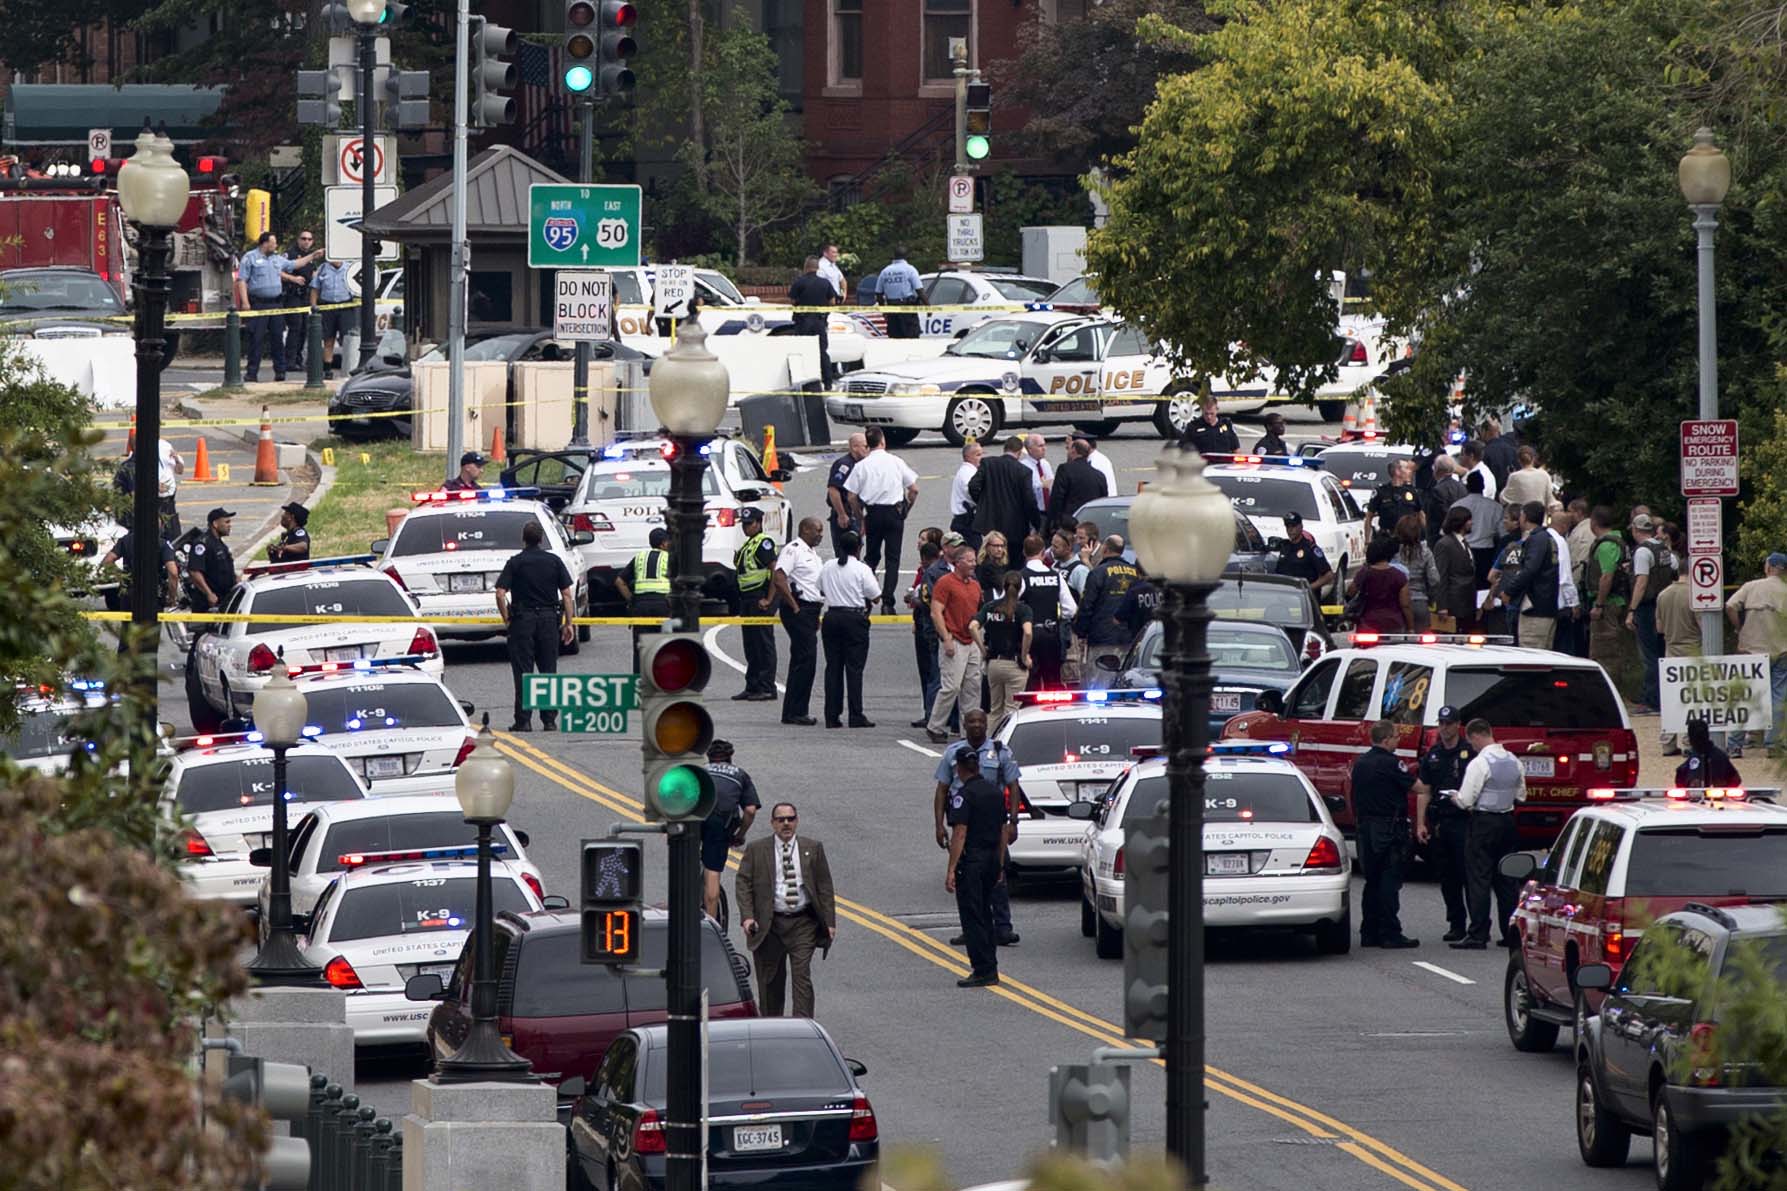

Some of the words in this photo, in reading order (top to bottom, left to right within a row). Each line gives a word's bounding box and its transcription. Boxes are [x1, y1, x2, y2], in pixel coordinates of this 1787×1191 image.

[581, 189, 590, 199] TO
[604, 201, 621, 211] EAST
[550, 227, 572, 245] 95
[601, 224, 625, 242] 50
[661, 269, 687, 279] STOP
[559, 281, 577, 296] DO
[582, 281, 608, 296] NOT
[664, 288, 684, 297] RED
[558, 303, 607, 319] BLOCK
[558, 322, 608, 334] INTERSECTION
[1050, 370, 1145, 395] POLICE
[1691, 424, 1727, 436] SNOW
[1684, 436, 1734, 444] EMERGENCY
[1688, 445, 1732, 456] ROUTE
[1685, 458, 1697, 467] NO
[1701, 458, 1734, 467] PARKING
[1352, 472, 1377, 480] K-9
[1695, 468, 1725, 477] DURING
[1685, 479, 1734, 487] EMERGENCY
[1230, 497, 1256, 506] K-9
[623, 507, 664, 517] POLI
[457, 531, 483, 541] K-9
[1106, 565, 1137, 577] POLICE
[1029, 576, 1059, 587] POLICE
[315, 603, 342, 614] K-9
[1665, 662, 1765, 683] SIDEWALK
[530, 677, 629, 707] FIRST
[356, 708, 386, 719] K-9
[1685, 708, 1749, 726] AHEAD
[563, 712, 624, 732] 1-200
[1079, 745, 1111, 754] K-9
[252, 782, 275, 793] K-
[1550, 786, 1580, 798] CHIEF
[1205, 798, 1238, 809] K-9
[1205, 831, 1227, 840] ATES
[1228, 832, 1262, 840] CAPITOL
[1265, 832, 1293, 840] POLICE
[1203, 895, 1291, 907] scapitolpolice.gov
[417, 908, 451, 921] K-9
[606, 911, 629, 954] 13
